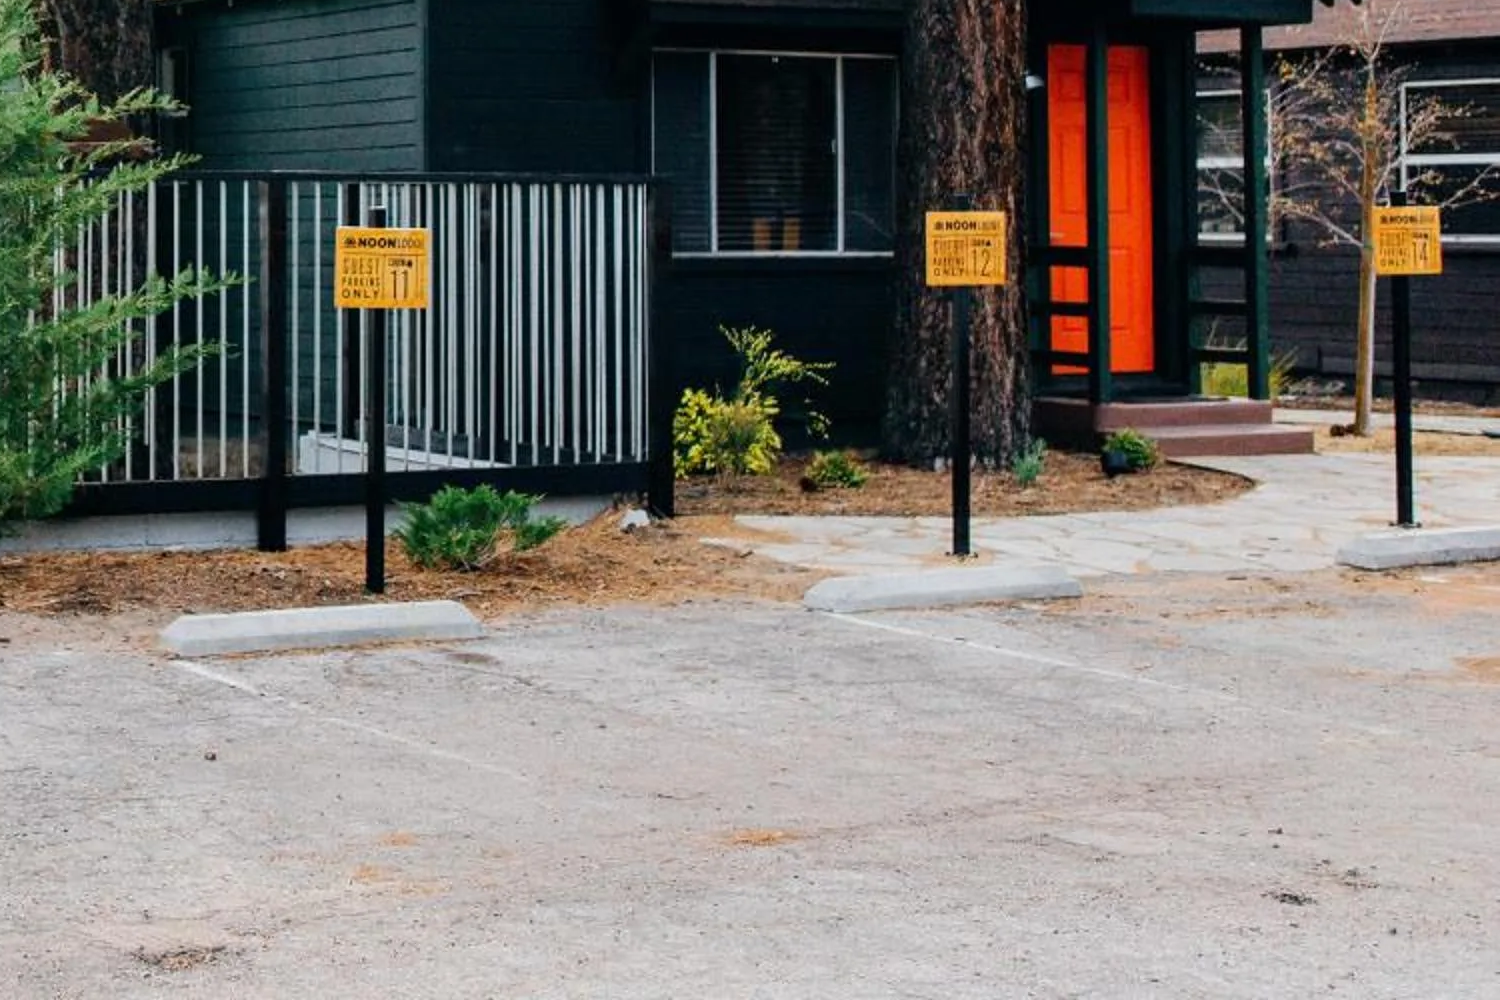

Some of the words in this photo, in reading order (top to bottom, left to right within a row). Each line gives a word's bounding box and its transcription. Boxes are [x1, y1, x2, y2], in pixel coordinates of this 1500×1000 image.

[973, 248, 990, 277] 12
[341, 289, 379, 299] ONLY
[390, 270, 408, 299] 11
